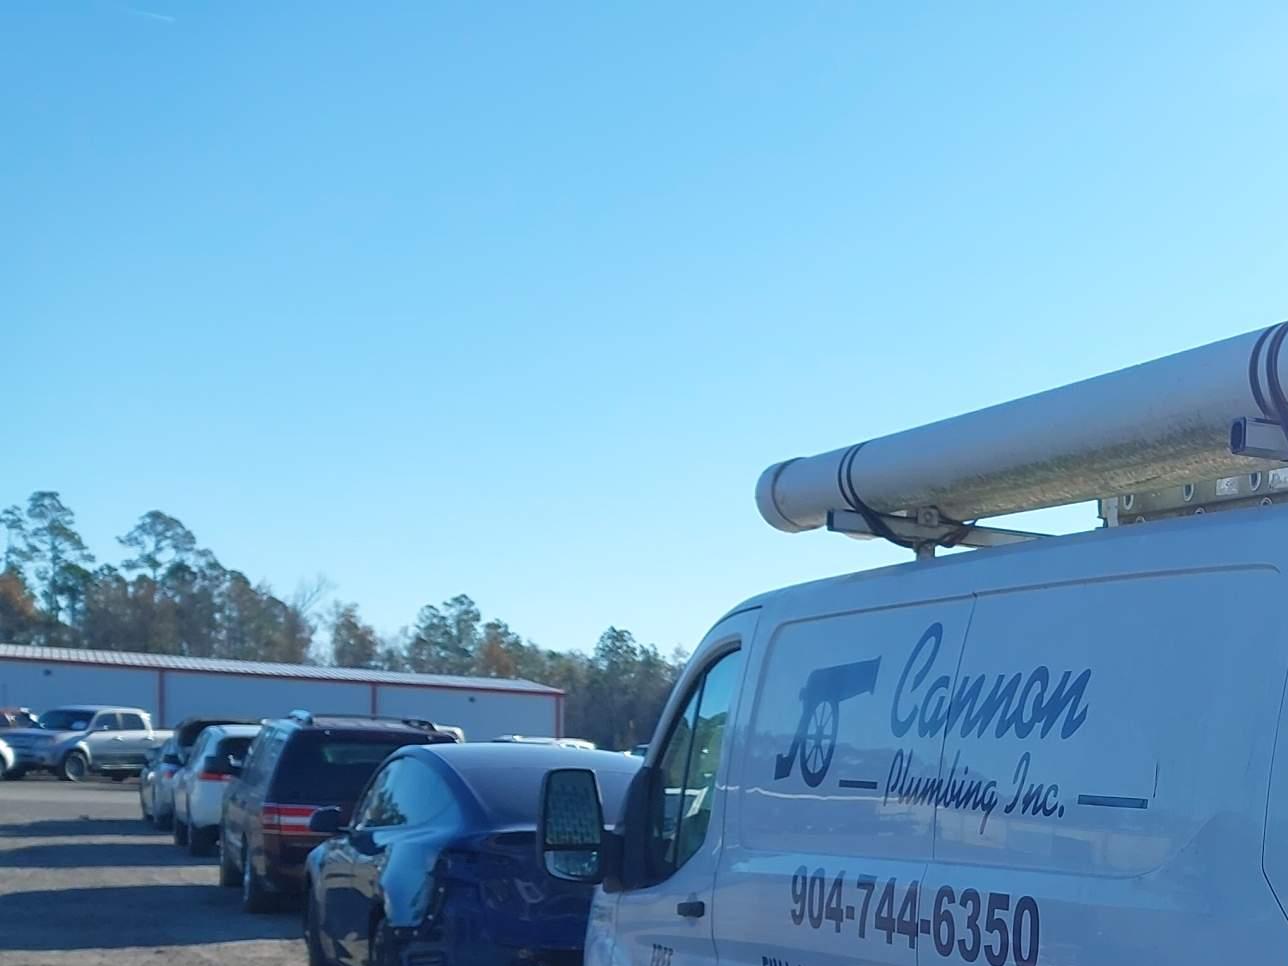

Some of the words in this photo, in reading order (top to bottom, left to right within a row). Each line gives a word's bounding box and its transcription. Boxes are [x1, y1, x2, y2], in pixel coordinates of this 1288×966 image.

[891, 622, 1091, 740] Cannon
[882, 750, 1000, 835] Plumbing
[1003, 752, 1064, 819] Inc.
